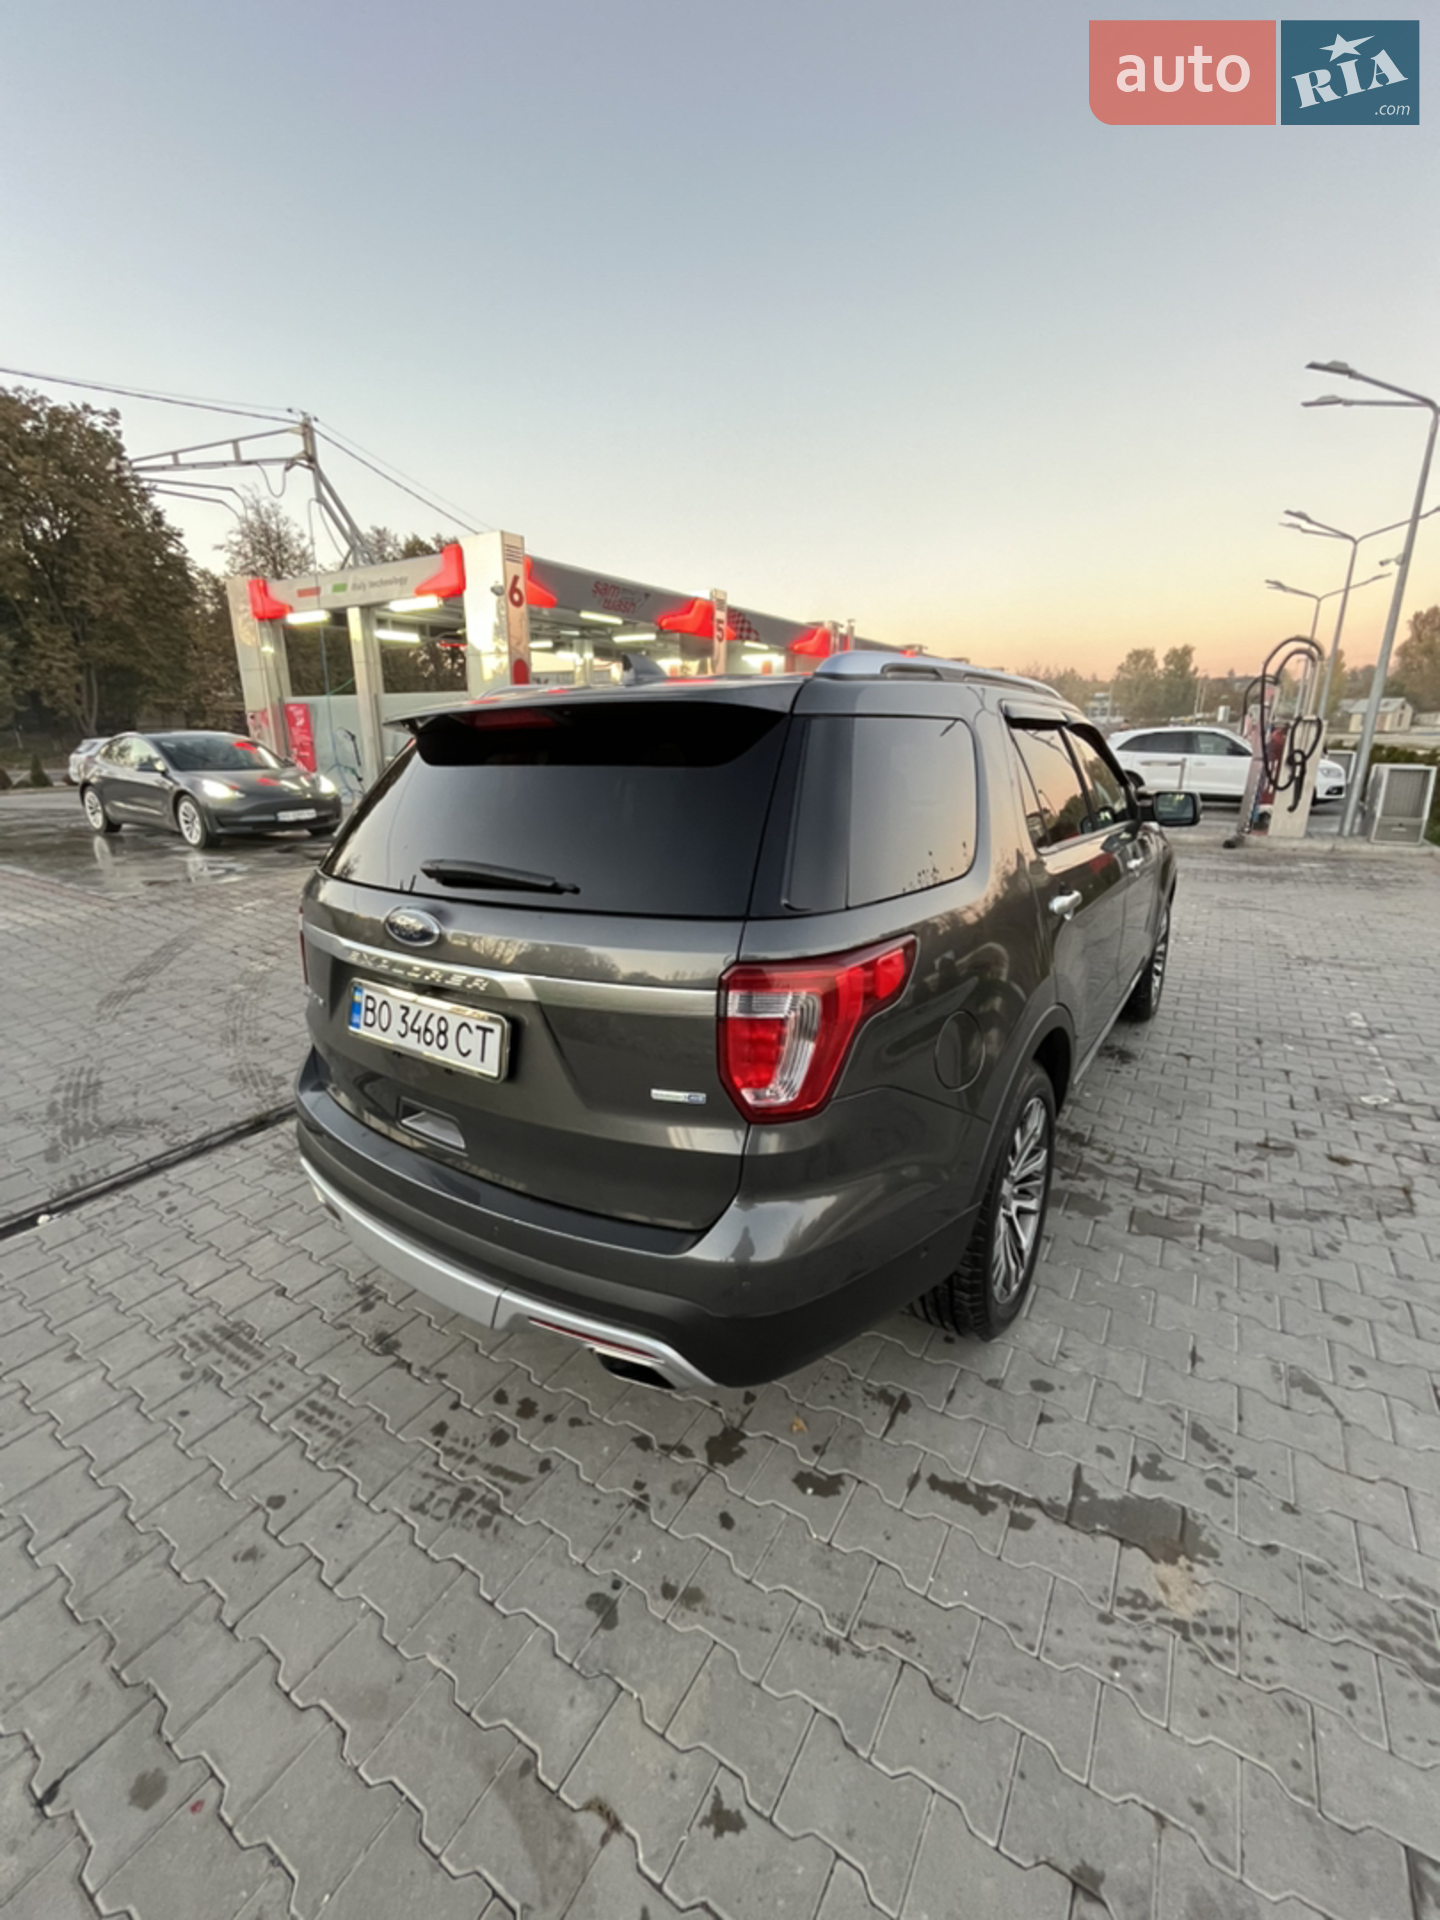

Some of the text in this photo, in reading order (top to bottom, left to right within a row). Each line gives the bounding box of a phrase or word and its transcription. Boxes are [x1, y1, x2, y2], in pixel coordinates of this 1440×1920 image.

[509, 574, 524, 608] 6
[715, 618, 725, 643] 5
[363, 995, 393, 1032] BO
[397, 1004, 449, 1051] 3468
[455, 1021, 495, 1064] CT
